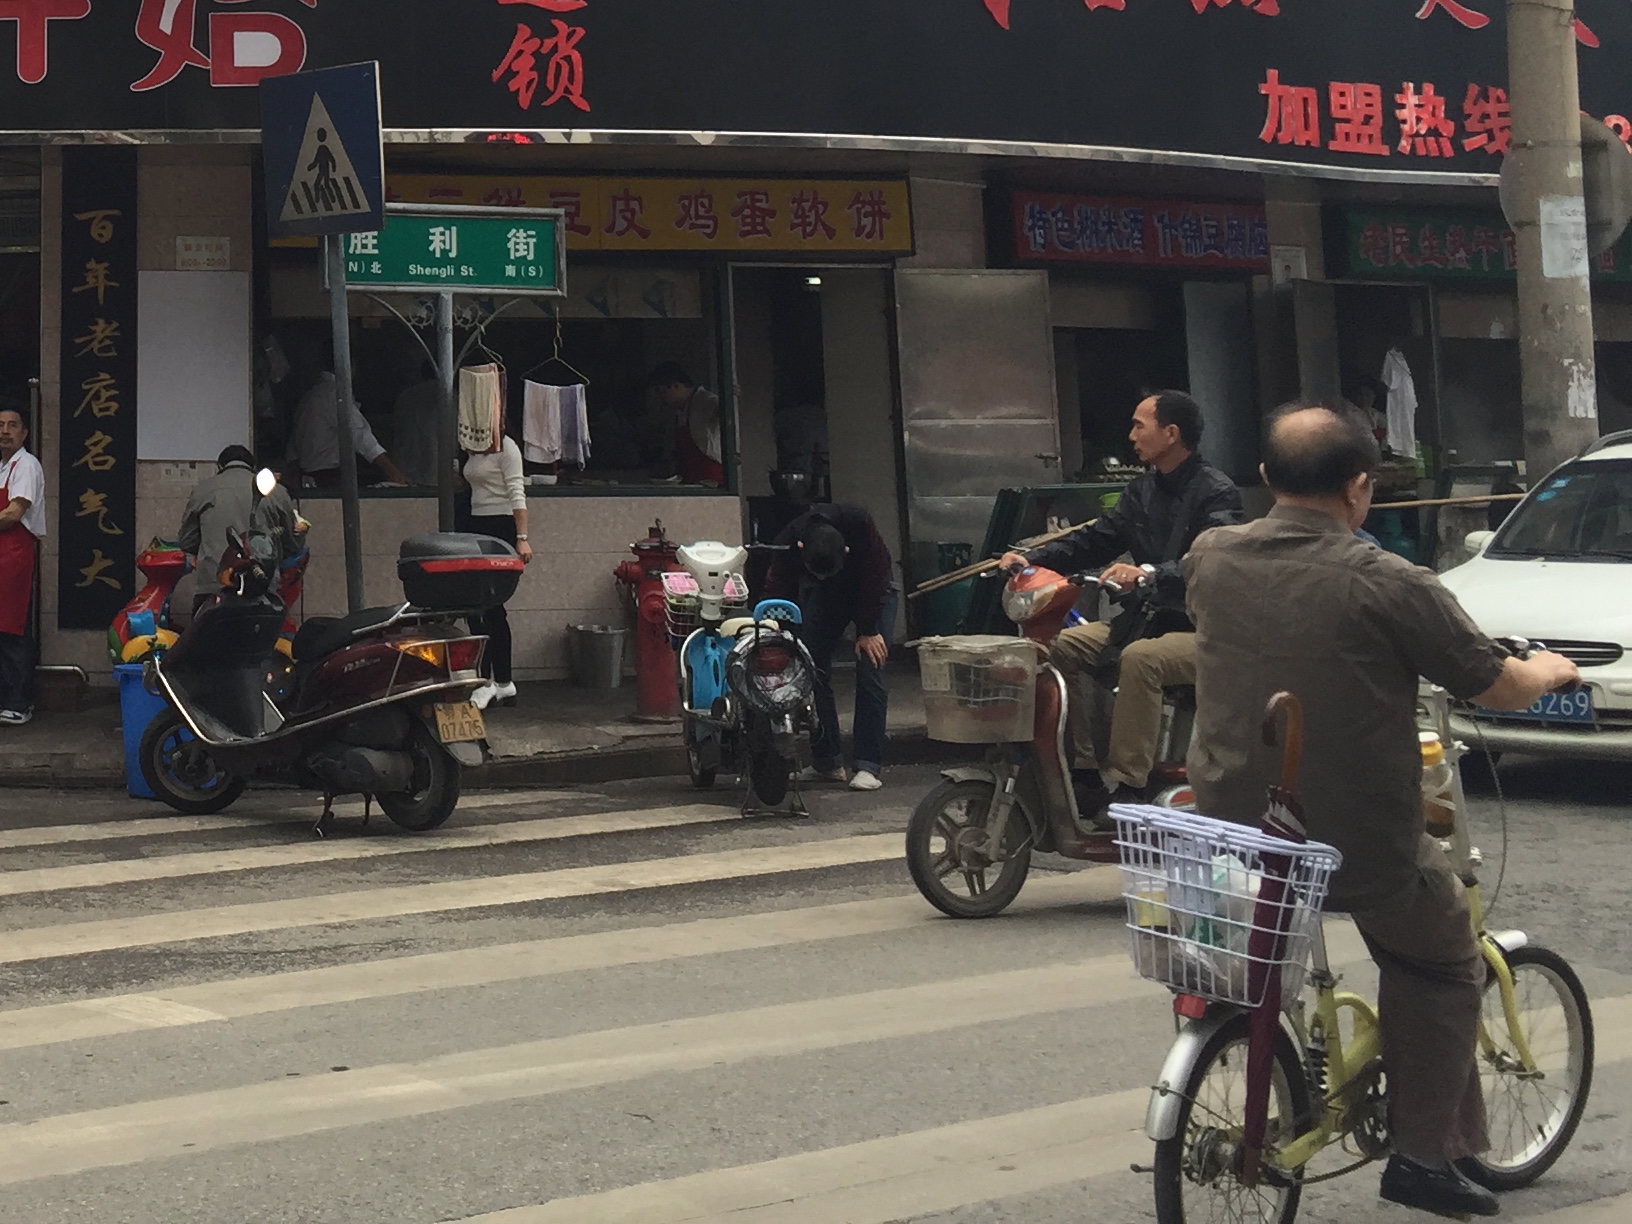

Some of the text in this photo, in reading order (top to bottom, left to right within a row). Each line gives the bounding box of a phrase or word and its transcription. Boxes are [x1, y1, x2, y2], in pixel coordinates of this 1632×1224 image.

[1258, 68, 1512, 158] 加盟热线
[348, 225, 537, 261] 胜利街
[408, 264, 477, 277] Shengli St.
[72, 208, 124, 590] 百年老店名气大
[441, 720, 484, 741] 07475
